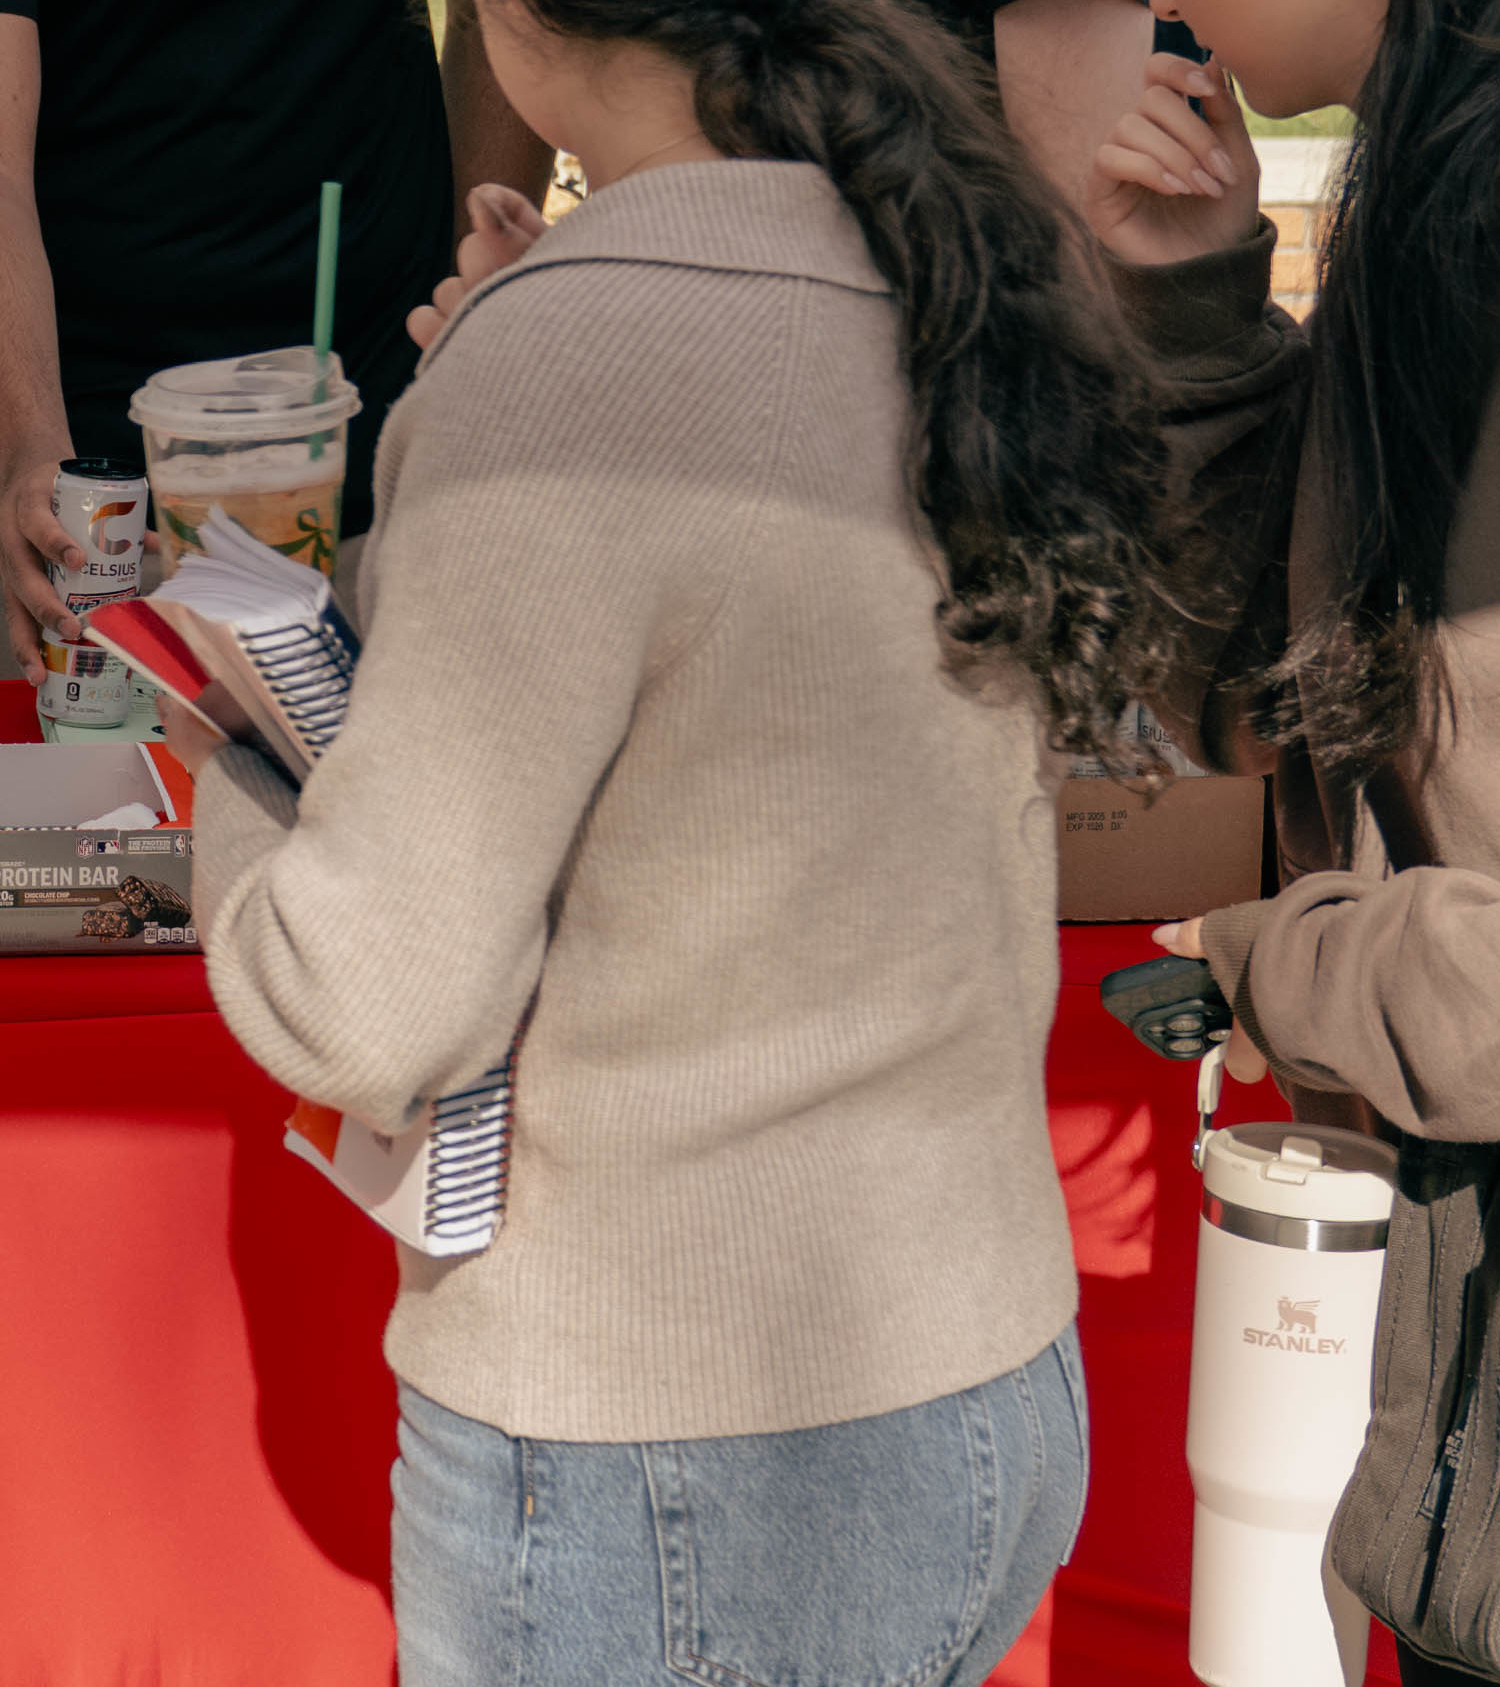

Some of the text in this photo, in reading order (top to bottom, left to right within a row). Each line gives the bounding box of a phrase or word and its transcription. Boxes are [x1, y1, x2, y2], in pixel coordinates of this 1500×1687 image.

[80, 562, 137, 577] CELSIUS
[1066, 823, 1083, 831] EXP
[79, 866, 119, 886] BAR
[1242, 1327, 1345, 1355] STANLEY
